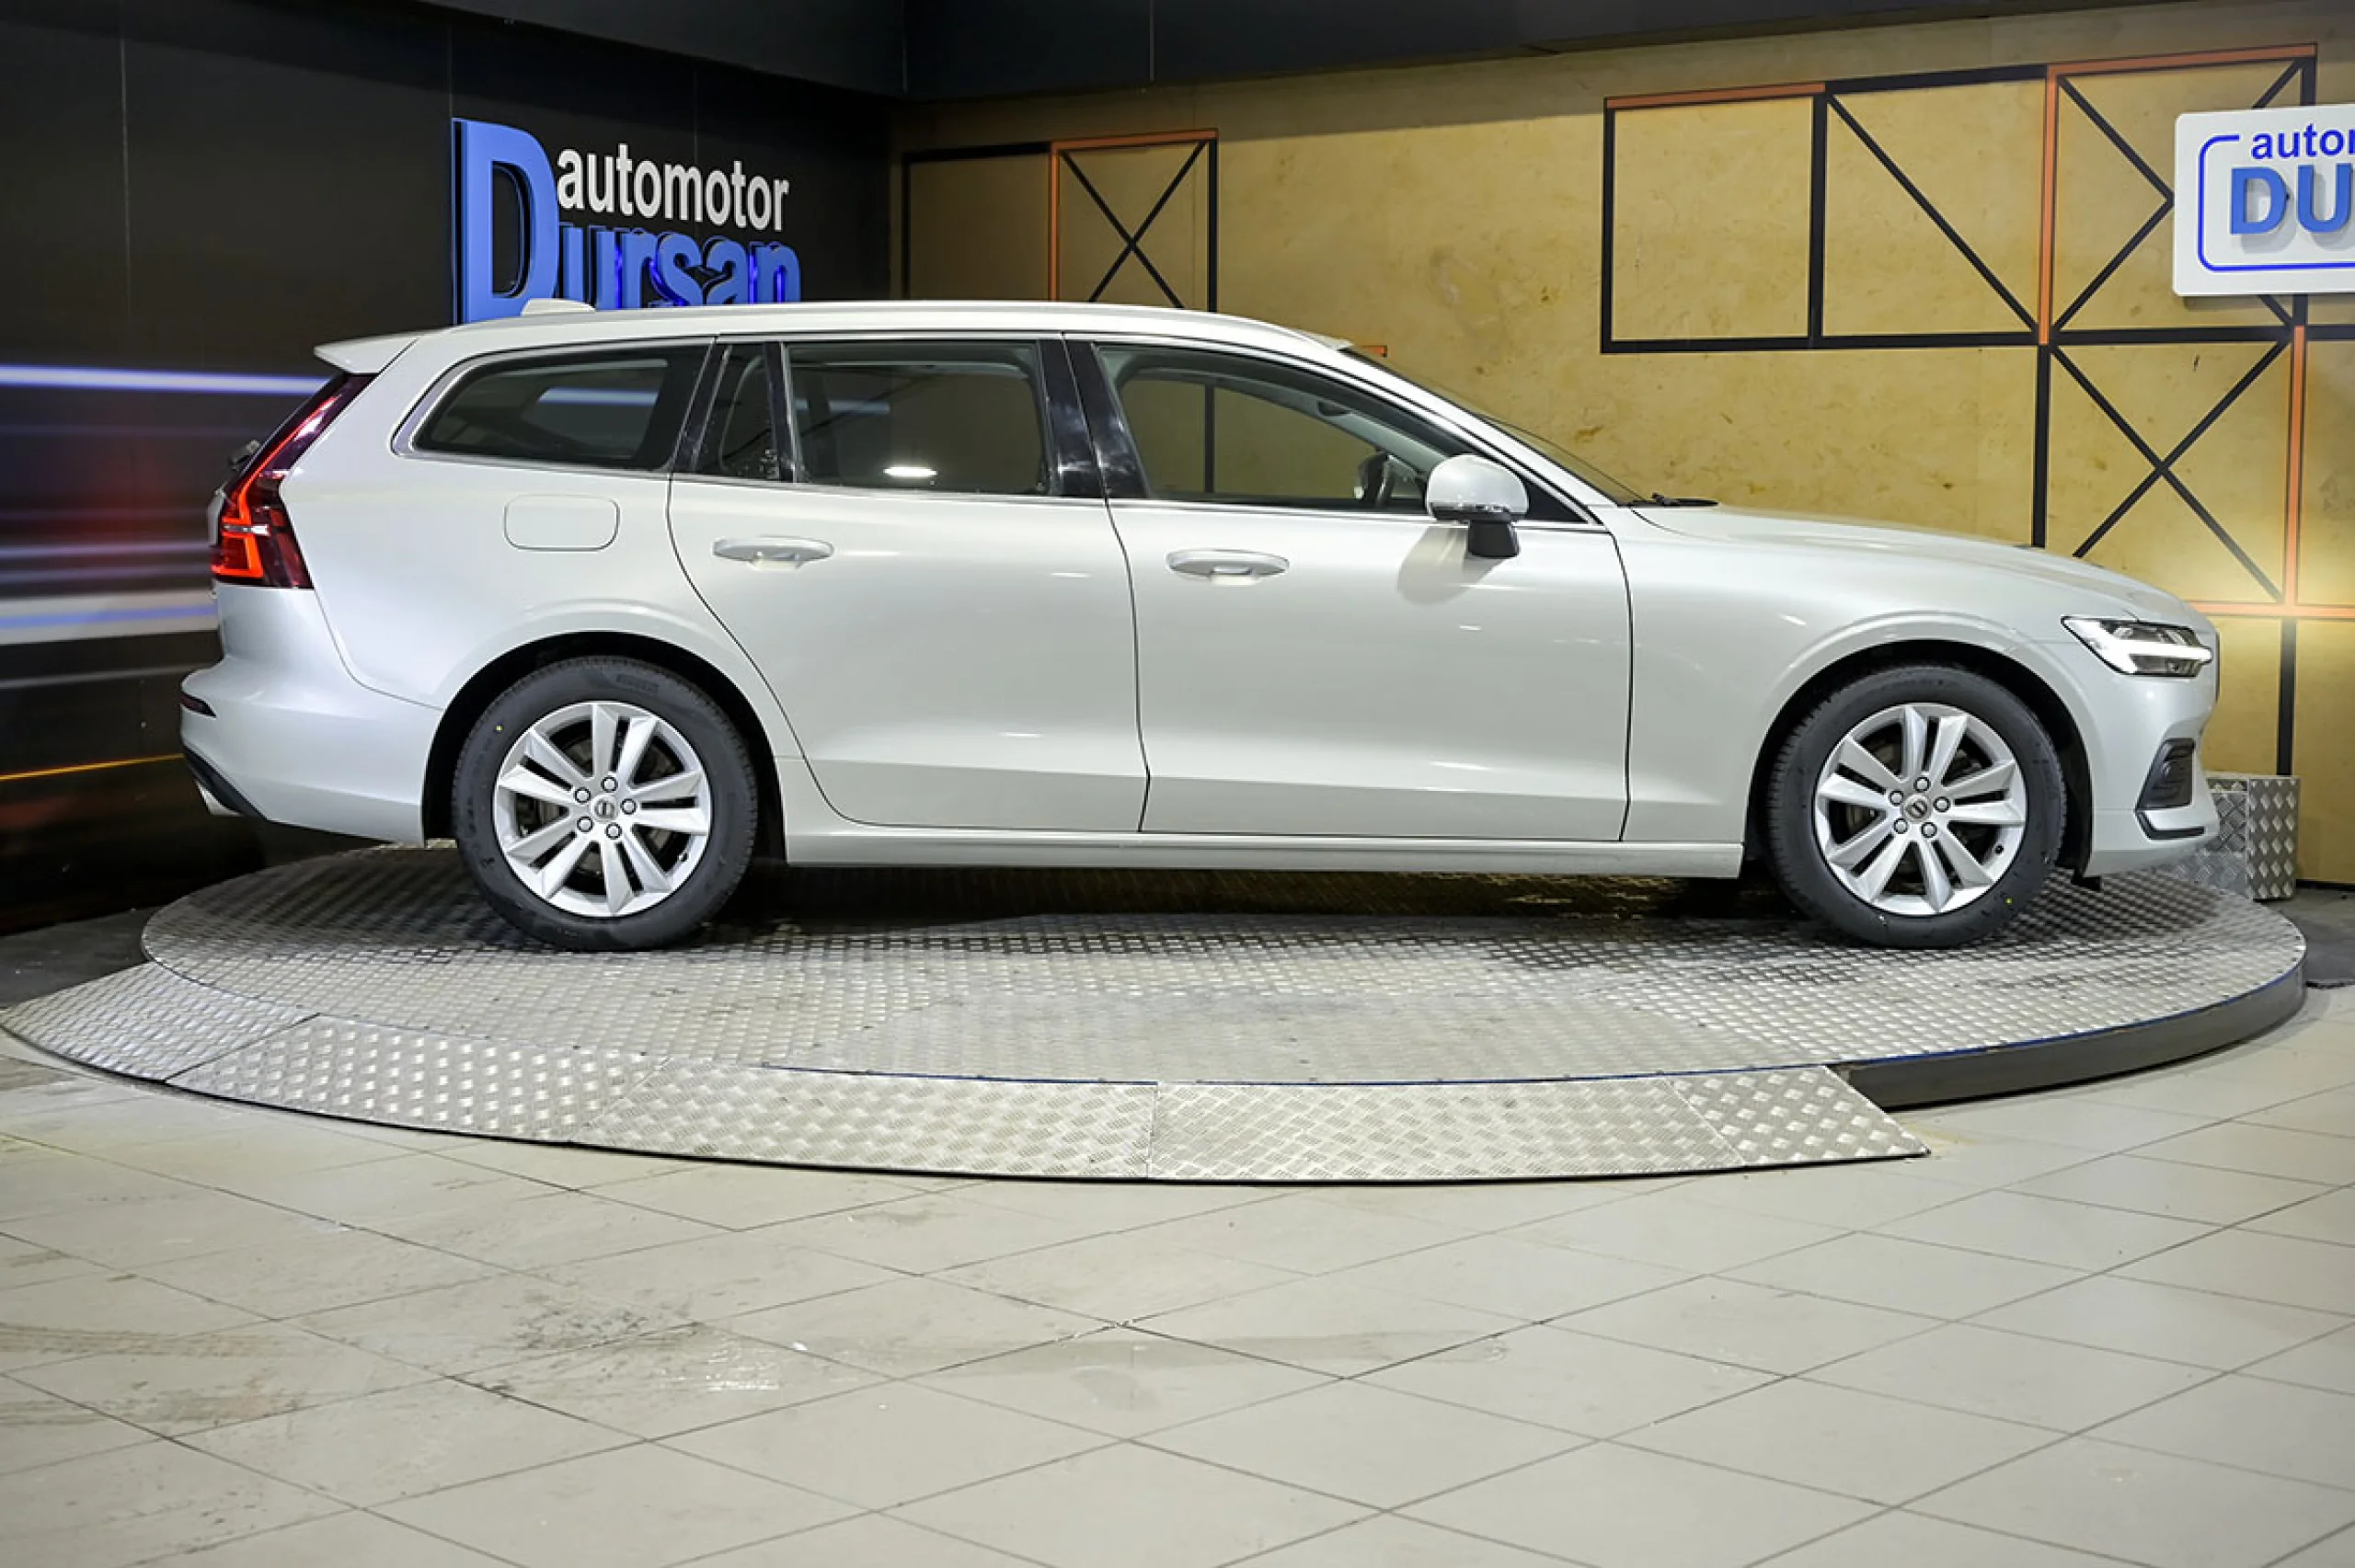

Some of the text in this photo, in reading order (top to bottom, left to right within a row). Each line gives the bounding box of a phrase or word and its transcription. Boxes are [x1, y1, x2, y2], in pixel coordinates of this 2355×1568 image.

[2253, 123, 2355, 159] auto
[453, 118, 801, 325] Dursan
[557, 143, 790, 232] automotor
